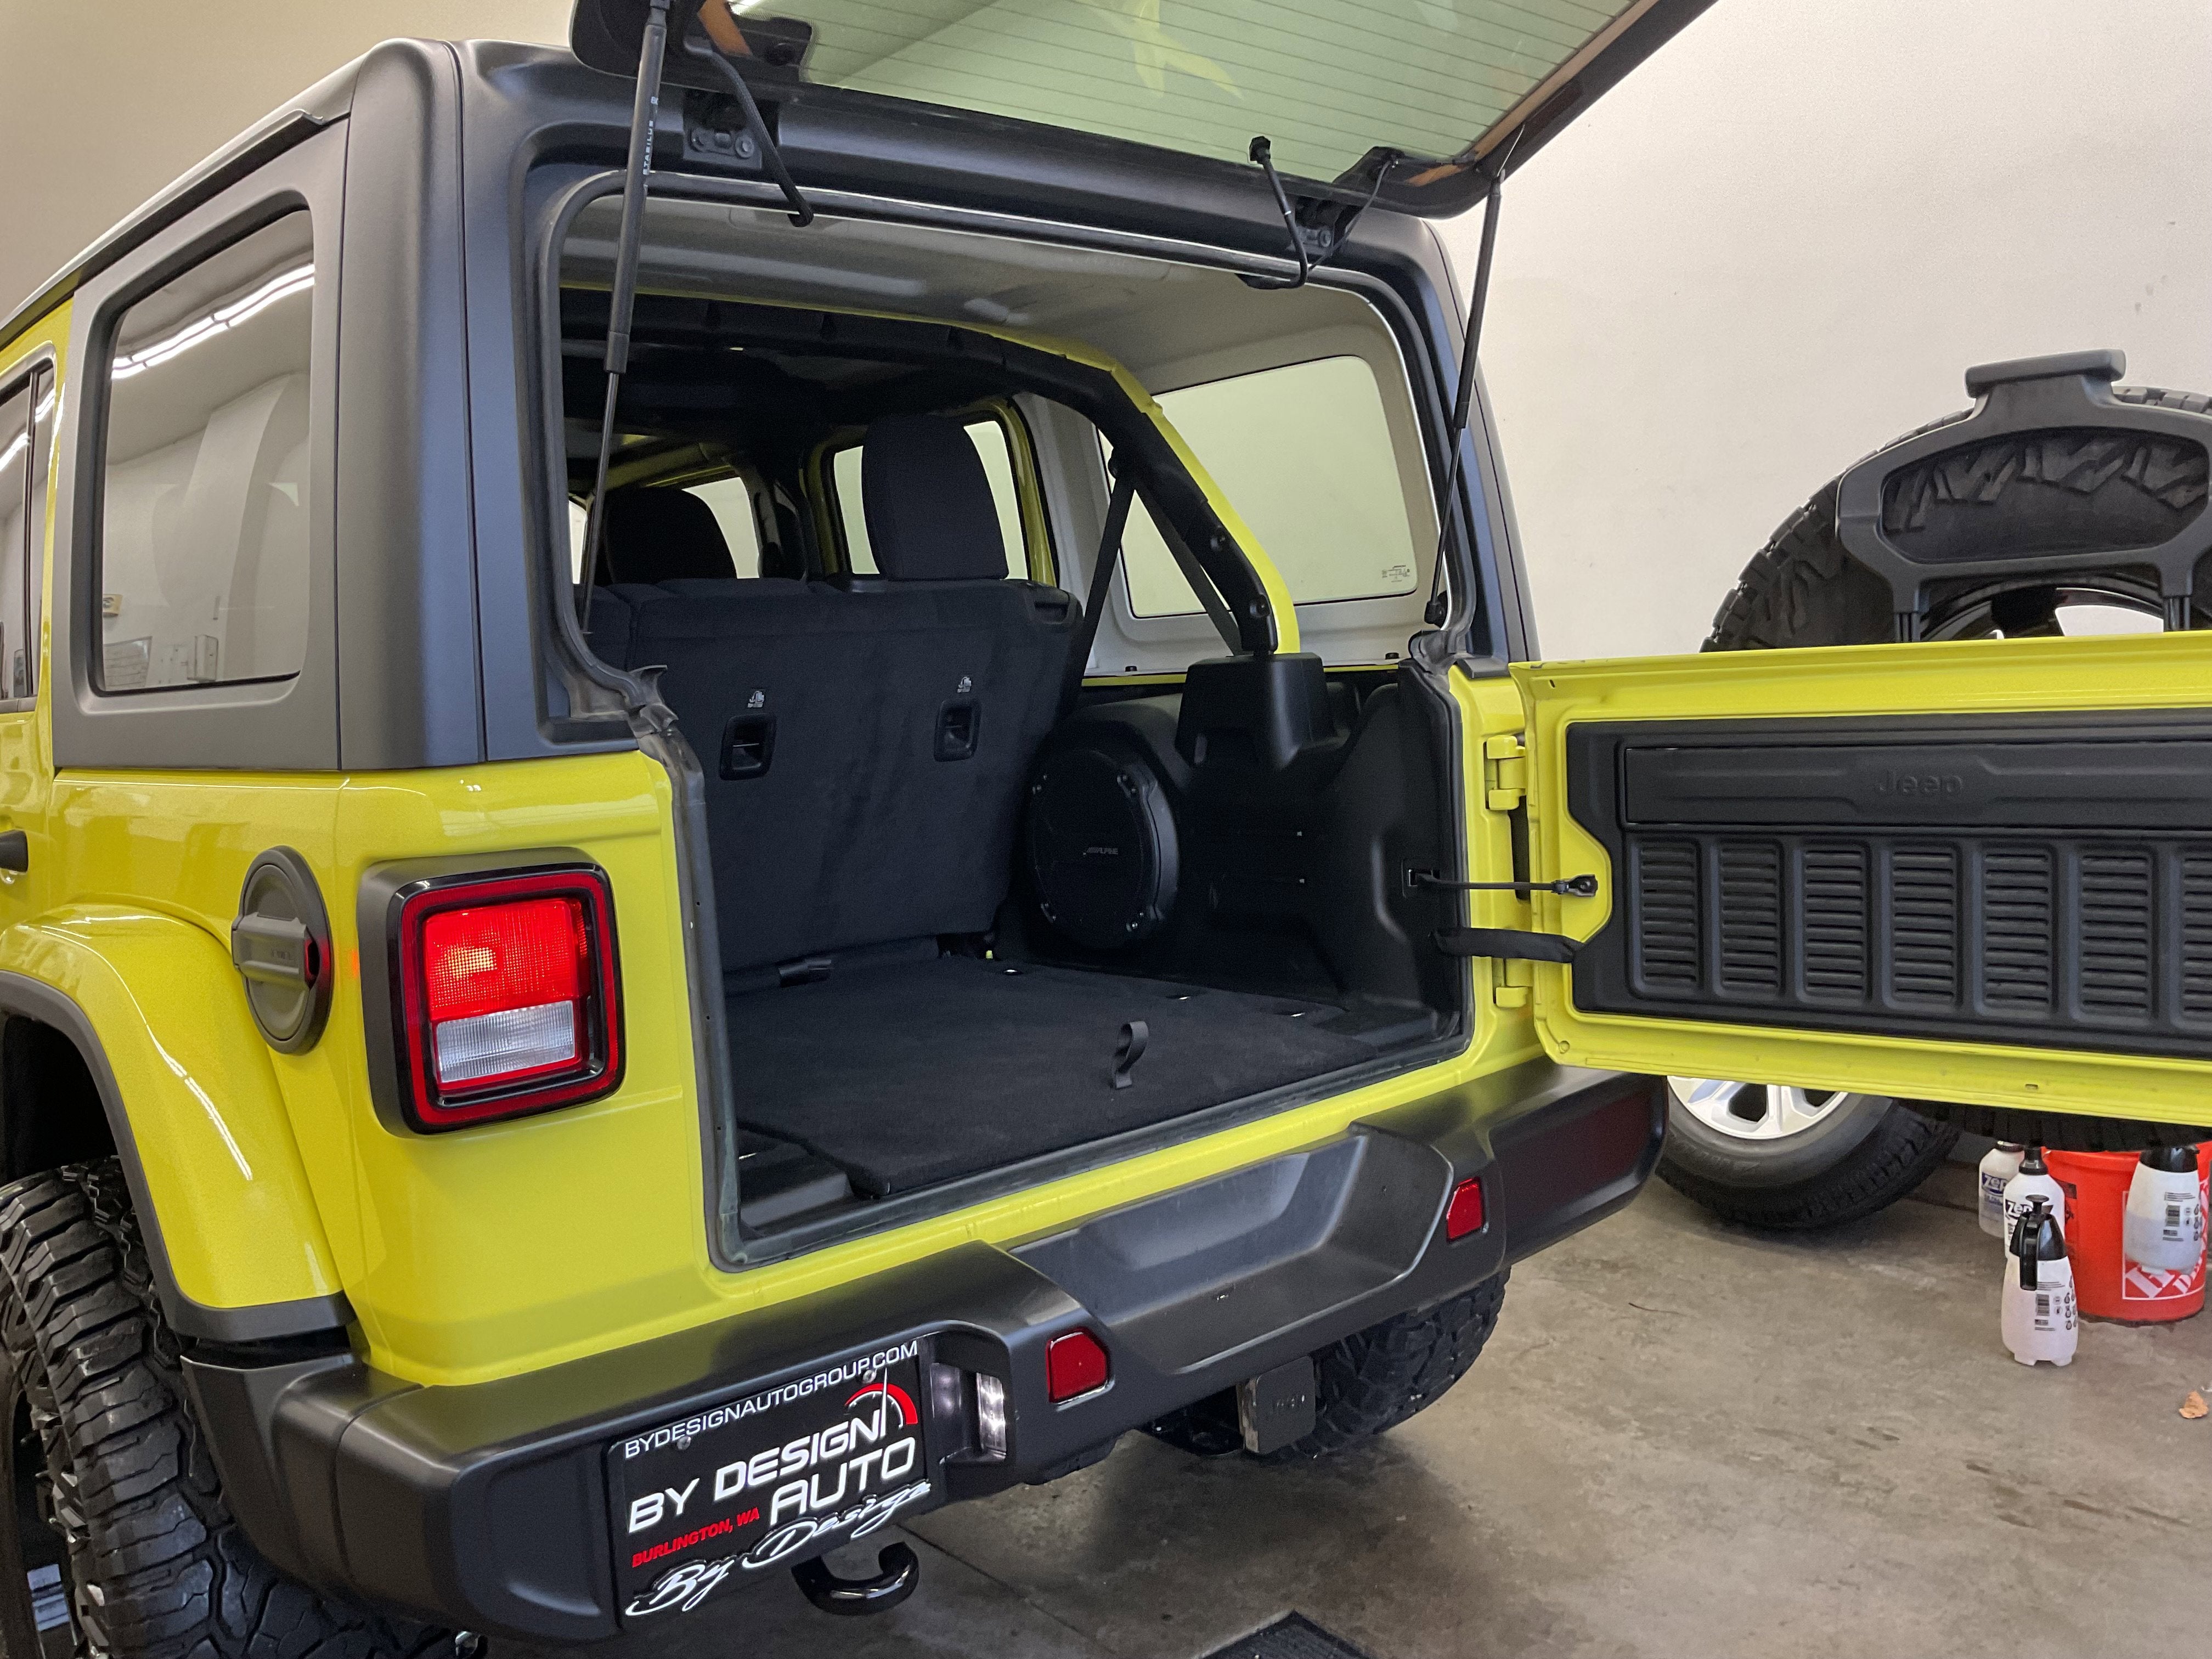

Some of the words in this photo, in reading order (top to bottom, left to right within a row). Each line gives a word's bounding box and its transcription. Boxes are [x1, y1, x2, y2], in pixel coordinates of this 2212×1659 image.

[1875, 769, 1963, 793] Jeep
[624, 1340, 918, 1460] BYDESIGNAUTOGROUPCOM
[628, 1477, 700, 1534] BY
[714, 1408, 881, 1502] DESIGN
[769, 1436, 916, 1527] AUTO
[624, 1563, 736, 1617] By
[741, 1481, 932, 1570] Design
[631, 1518, 733, 1568] BURLINGTON,
[736, 1506, 760, 1527] WA
